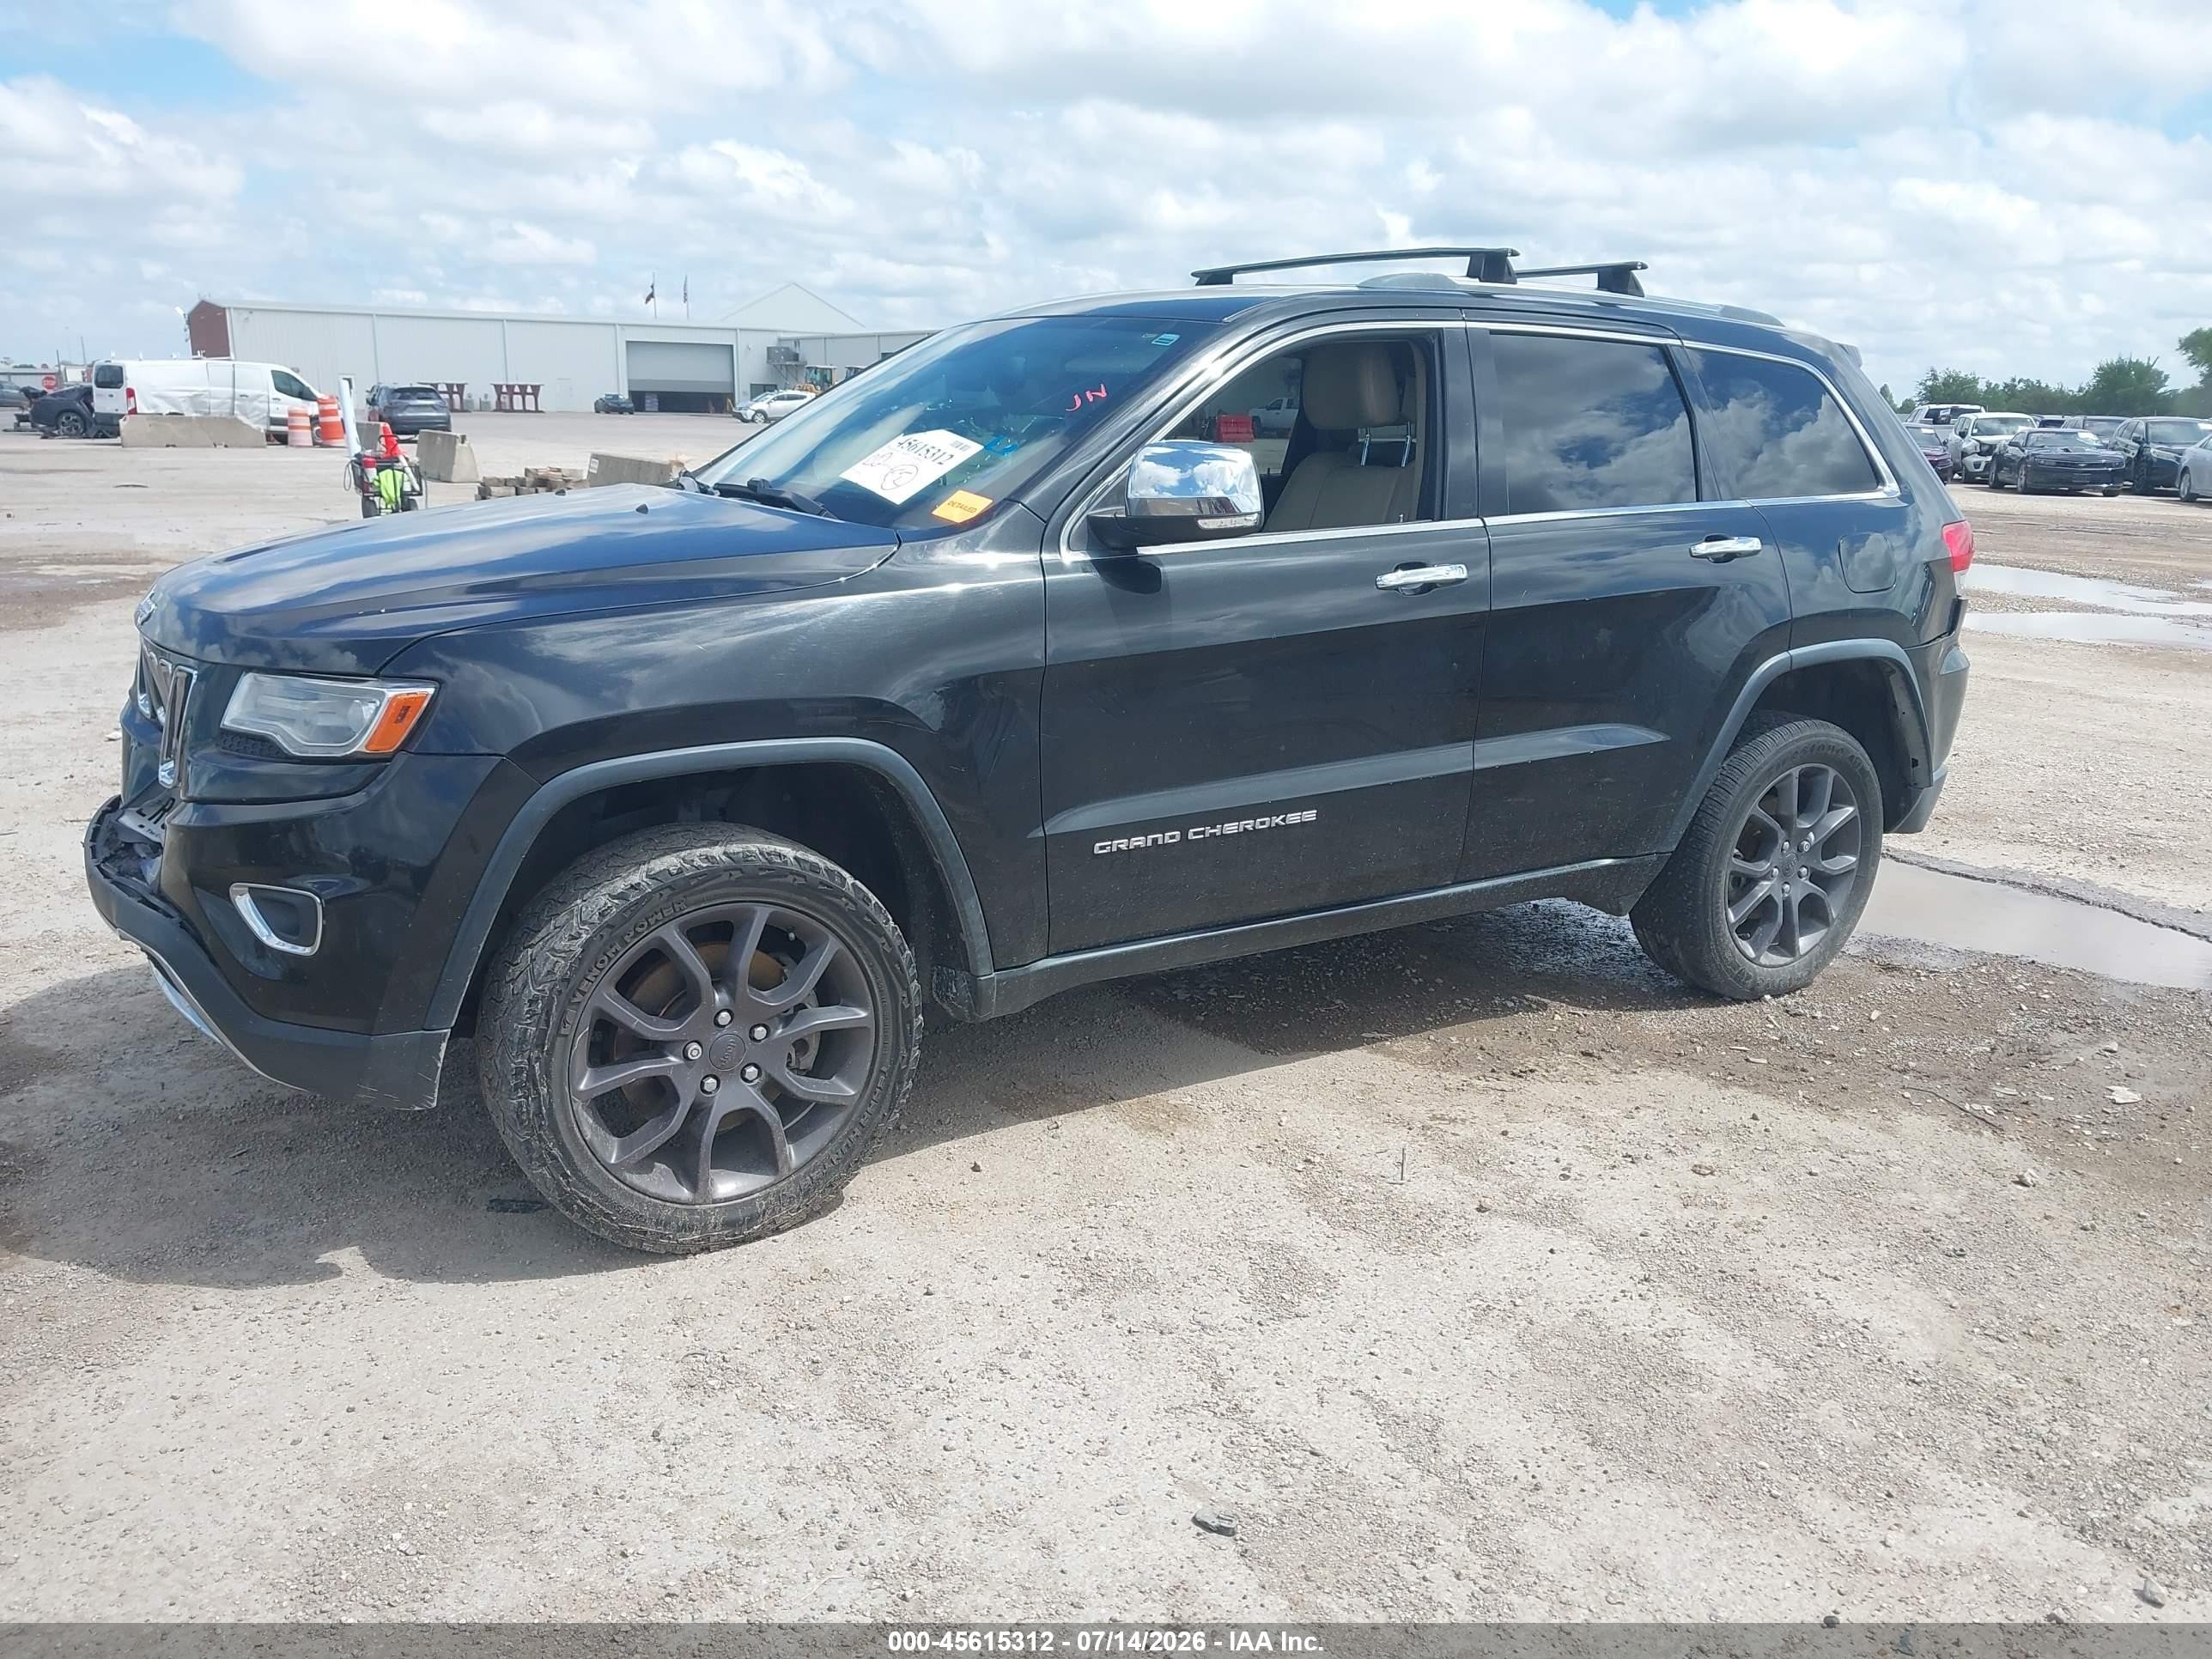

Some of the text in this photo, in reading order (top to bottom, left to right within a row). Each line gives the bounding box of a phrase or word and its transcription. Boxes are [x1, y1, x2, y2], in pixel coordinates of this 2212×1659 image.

[897, 437, 955, 465] 45615312
[947, 500, 978, 514] DETAILED
[1093, 810, 1317, 854] GRAND CHEROKEE
[570, 899, 689, 1004] VENOM POWER
